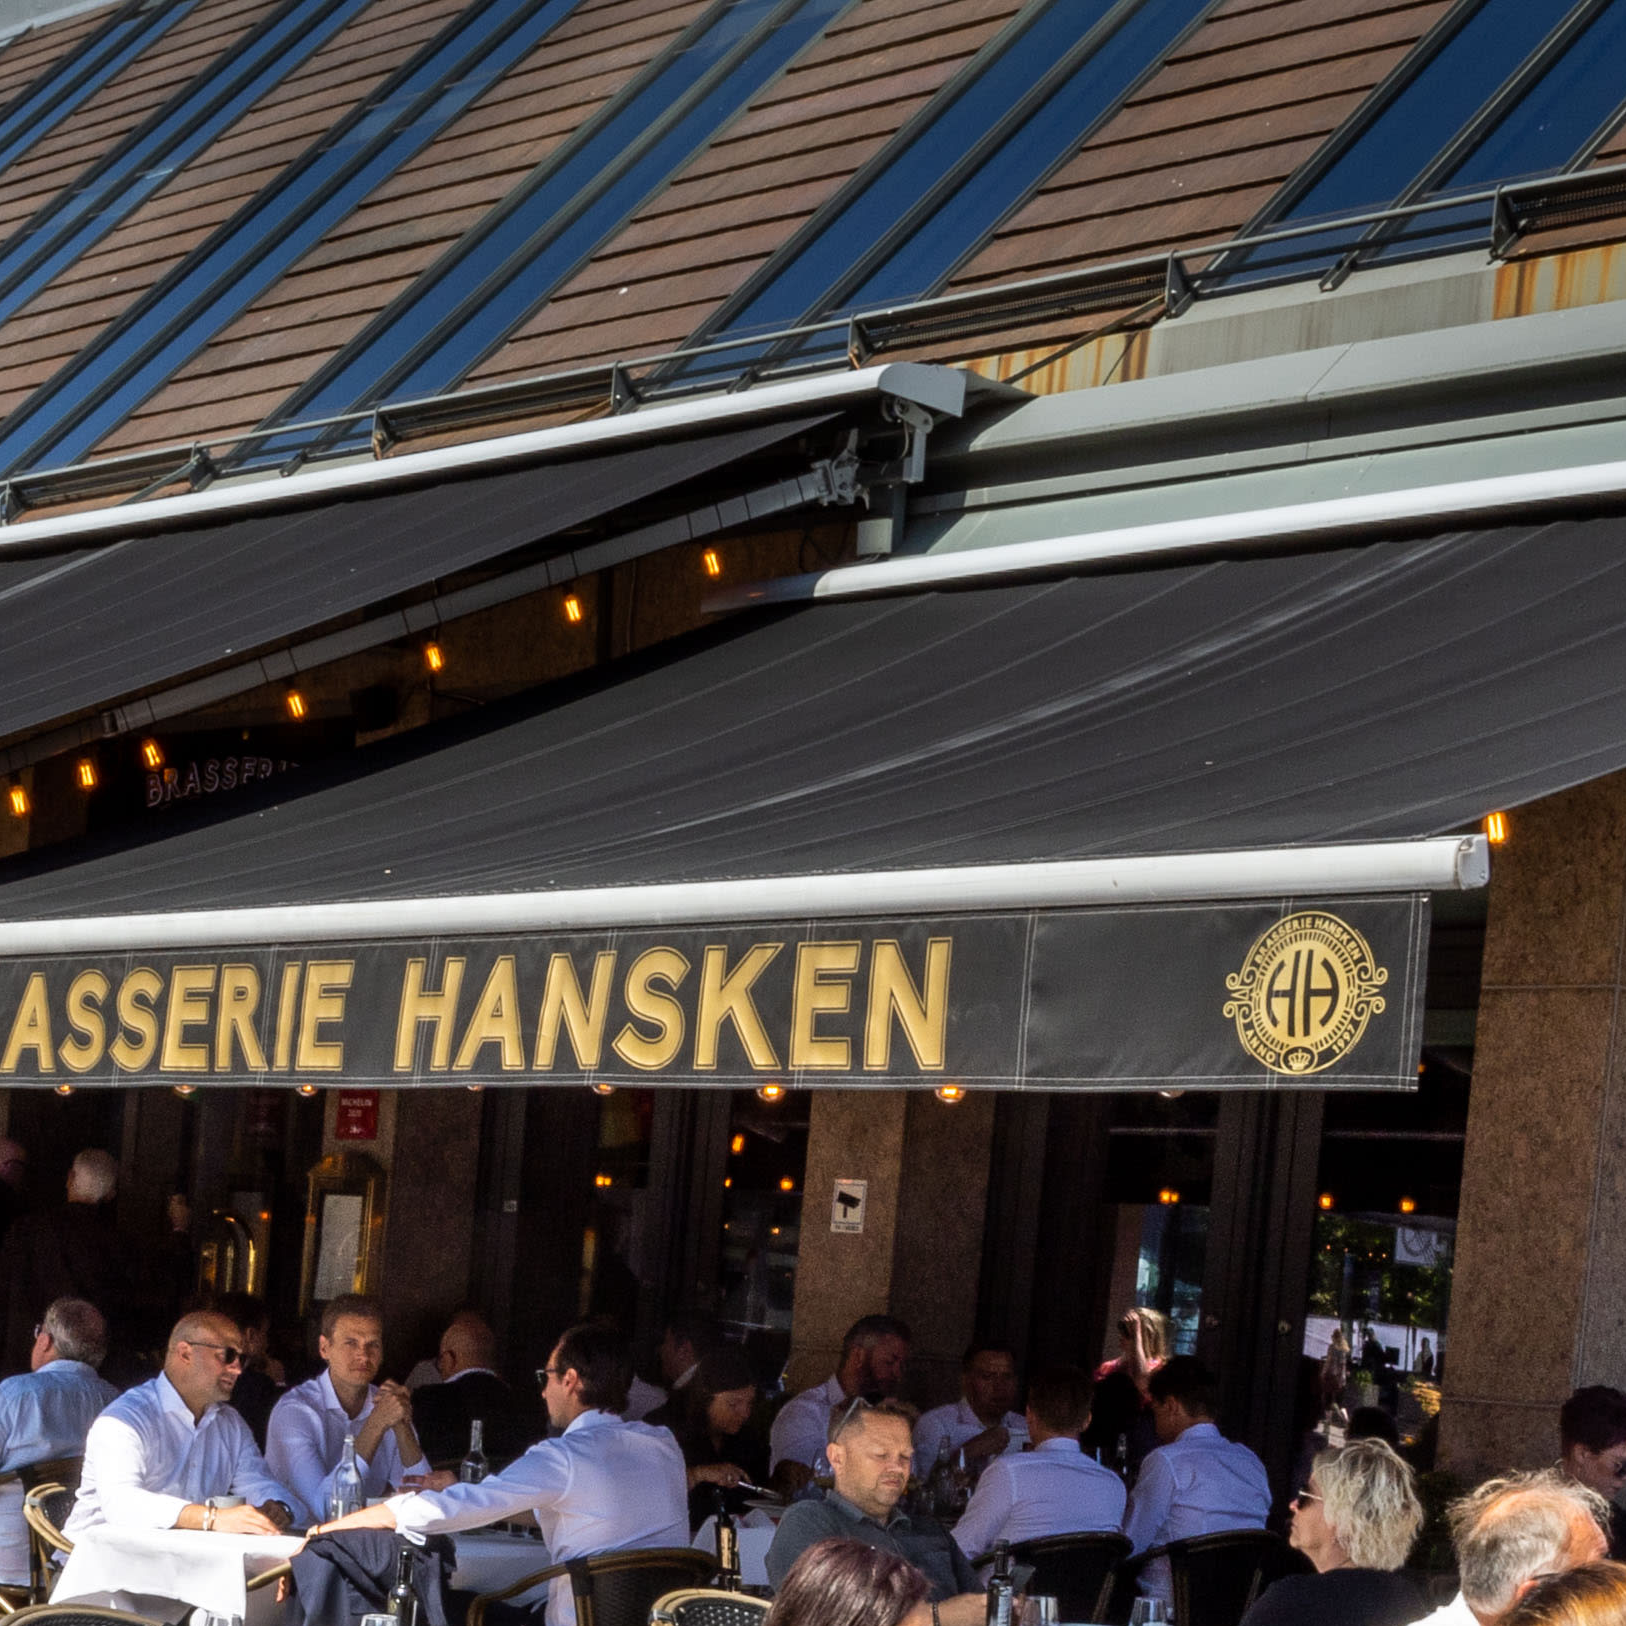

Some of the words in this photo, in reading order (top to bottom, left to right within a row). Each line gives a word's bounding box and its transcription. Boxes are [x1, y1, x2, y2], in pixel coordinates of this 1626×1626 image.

[1254, 917, 1313, 964] BRASSERIE
[1314, 918, 1363, 961] HANSKEN
[393, 937, 952, 1072] HANSKEN
[1246, 1029, 1276, 1063] ANNO
[1331, 1024, 1357, 1054] 1997
